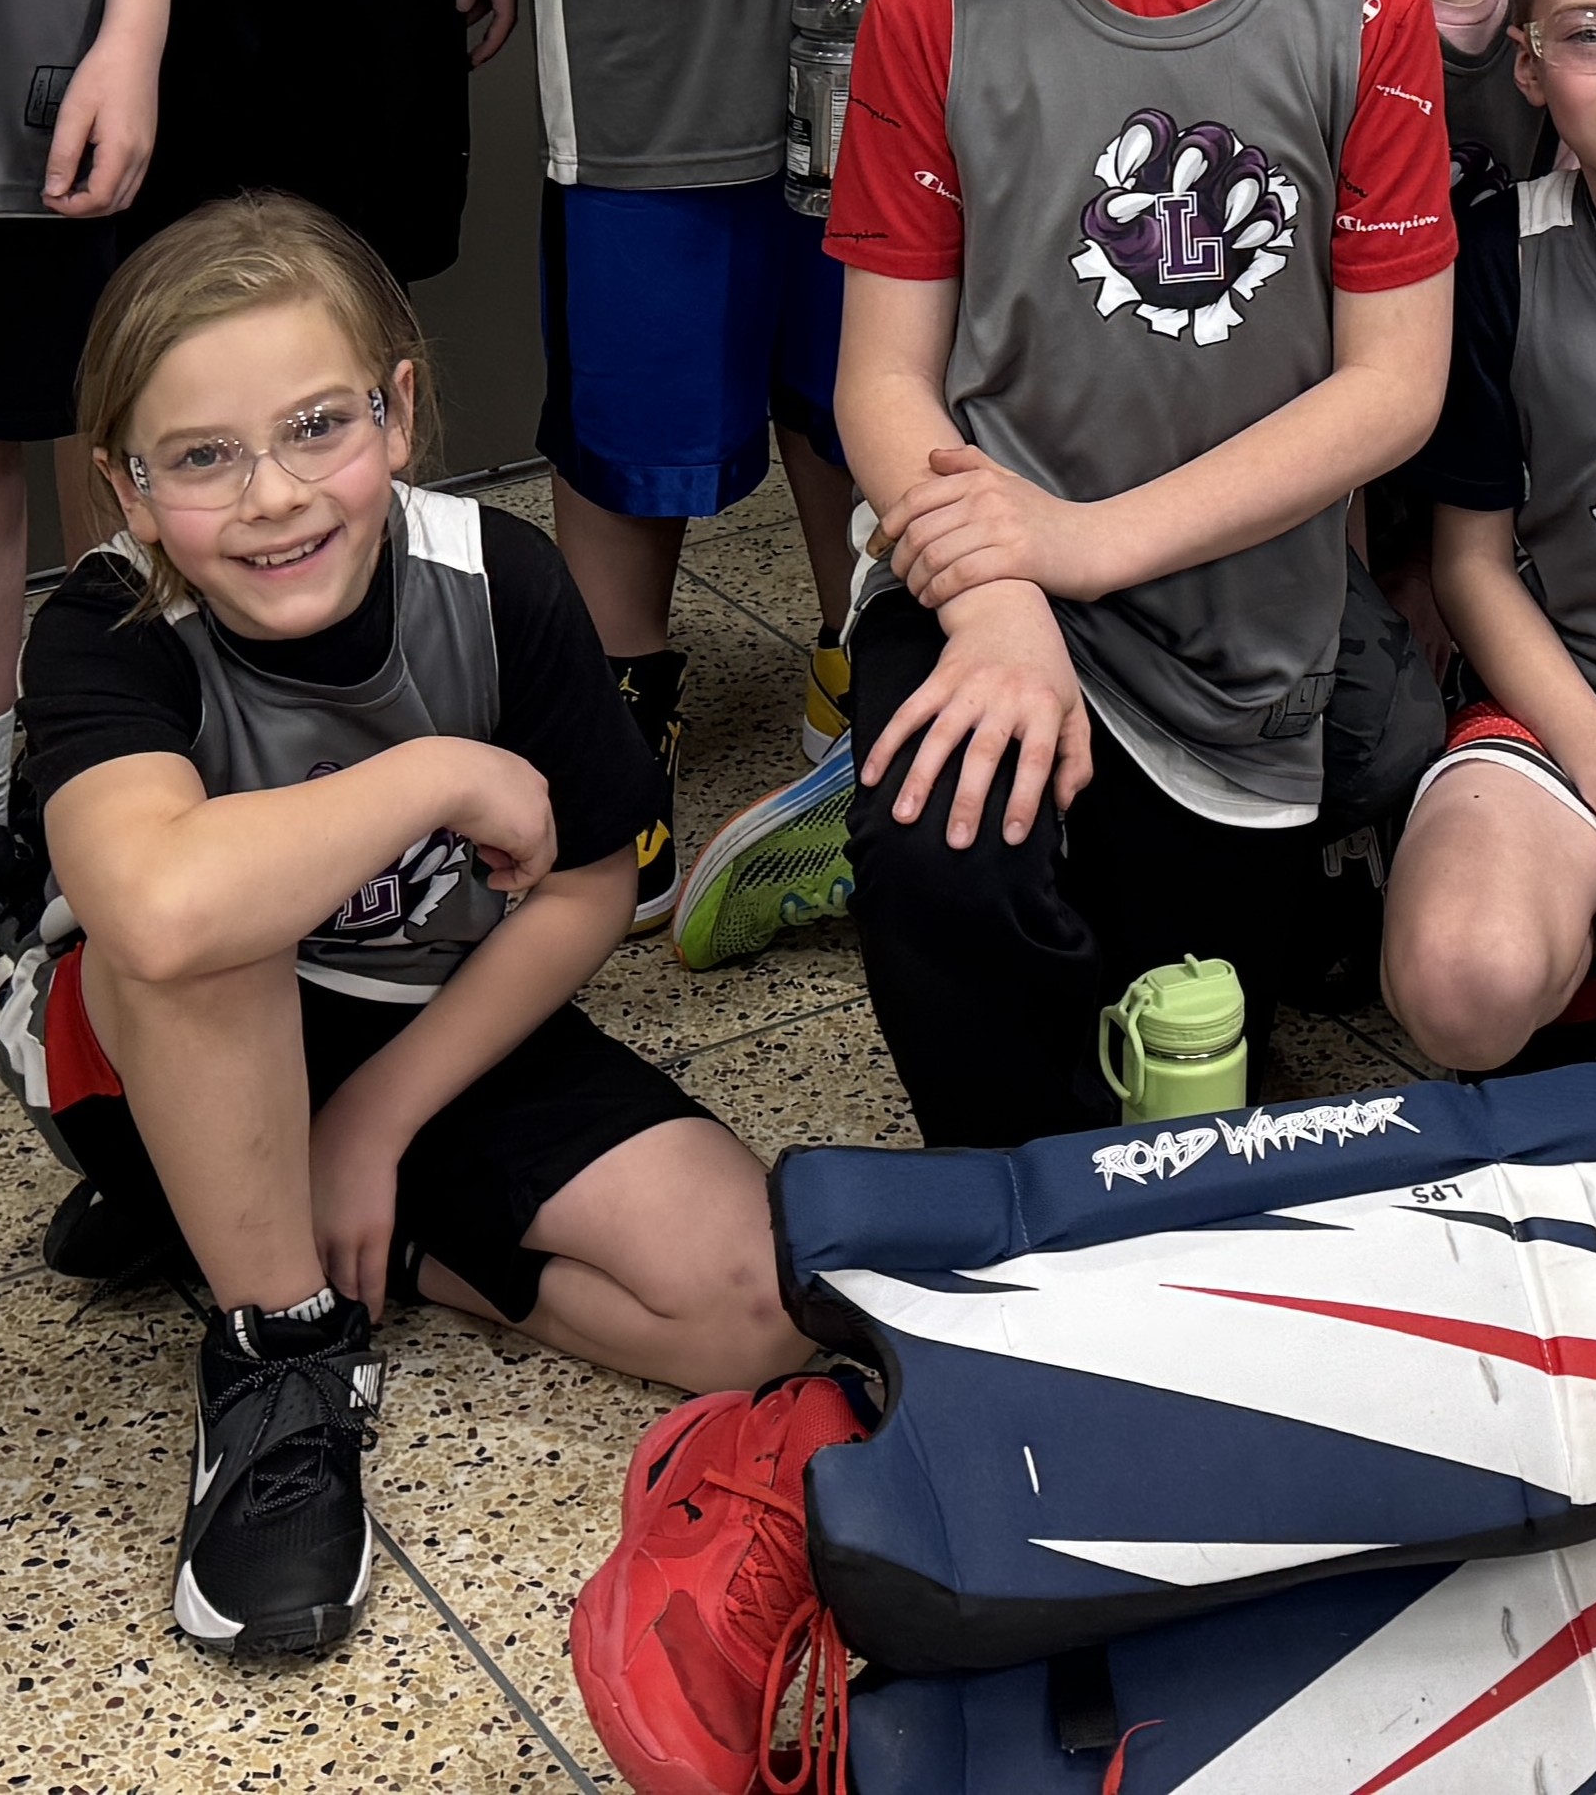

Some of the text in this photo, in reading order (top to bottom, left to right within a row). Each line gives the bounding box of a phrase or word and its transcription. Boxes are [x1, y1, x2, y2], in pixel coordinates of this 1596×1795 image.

[1154, 191, 1225, 285] L
[1335, 214, 1440, 236] Champion
[1091, 1126, 1219, 1191] ROAD
[1411, 1183, 1463, 1204] LPS
